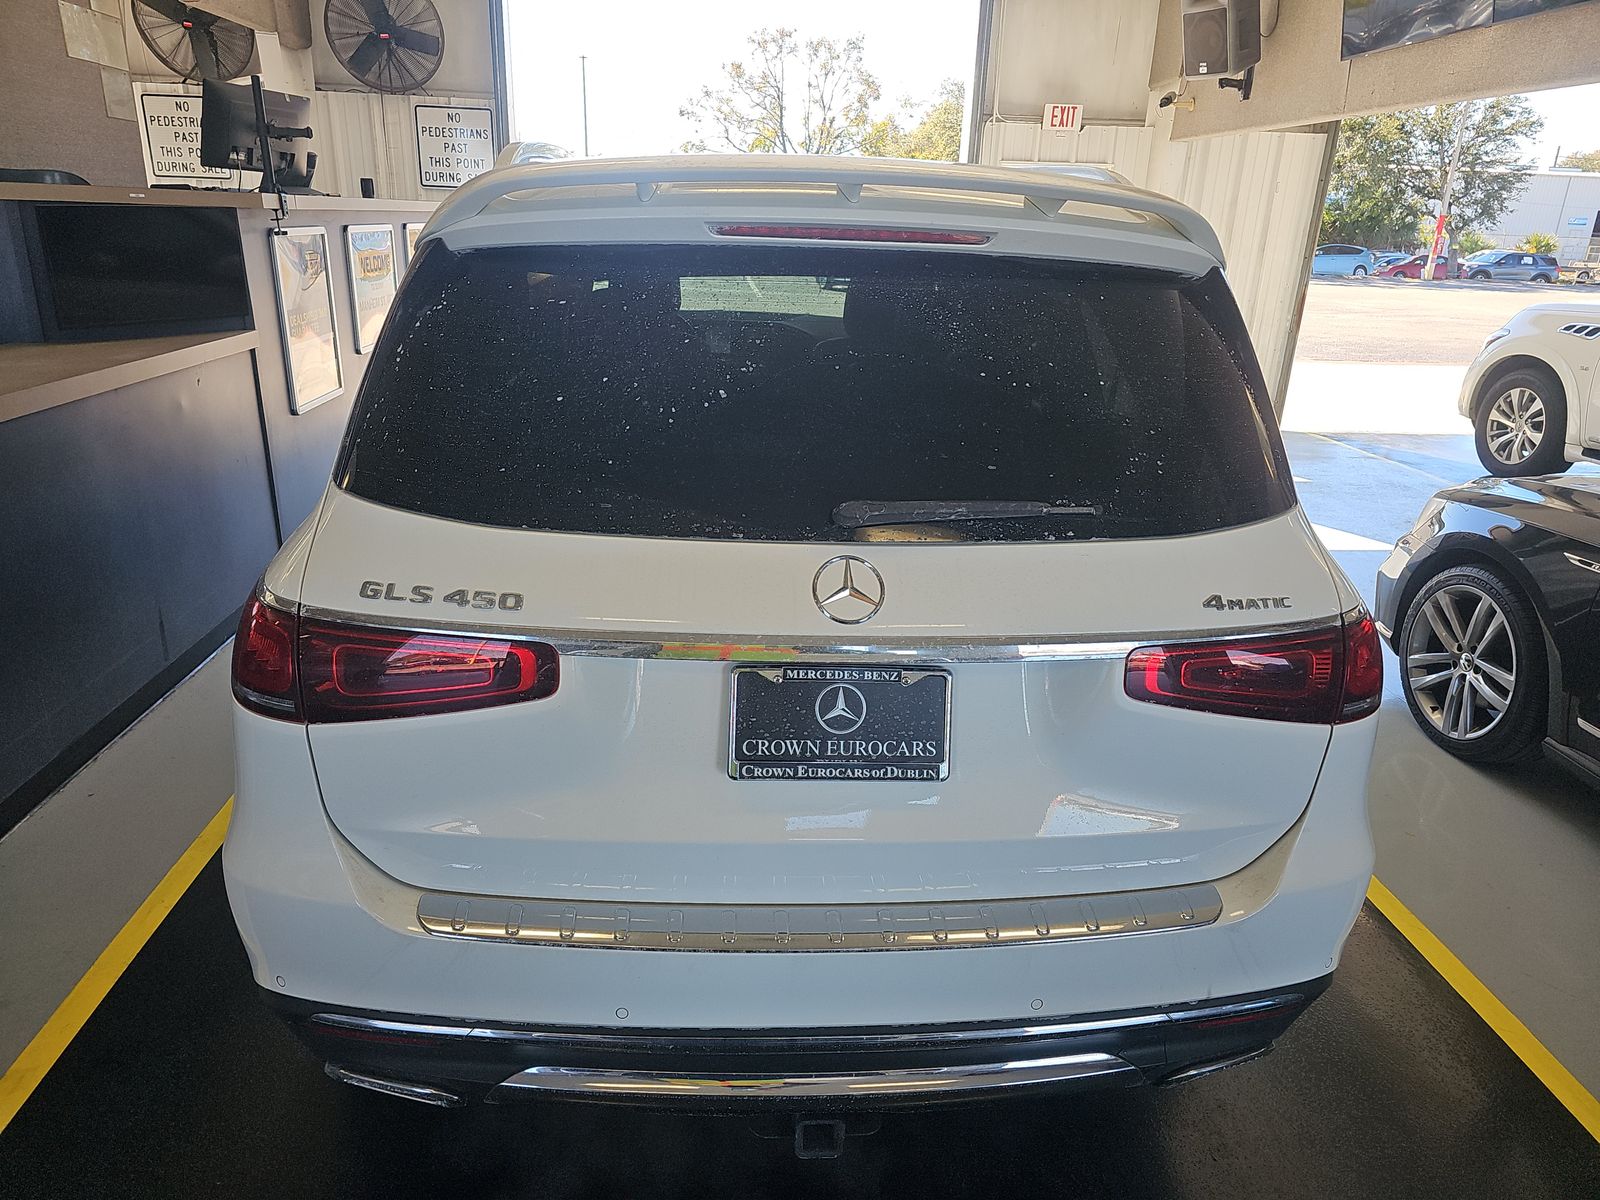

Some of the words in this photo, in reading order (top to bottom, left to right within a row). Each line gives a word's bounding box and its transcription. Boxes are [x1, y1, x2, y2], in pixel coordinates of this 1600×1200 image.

[175, 101, 190, 113] NO
[150, 115, 201, 128] PEDESTRI
[447, 112, 461, 124] NO
[1050, 105, 1078, 128] EXIT
[174, 131, 199, 143] PAST
[421, 126, 489, 140] PEDESTRIANS
[160, 146, 183, 158] THIS
[443, 142, 468, 154] PAST
[156, 161, 196, 173] DURING
[429, 156, 451, 168] THIS
[456, 157, 485, 170] POINT
[424, 171, 462, 183] DURING
[360, 253, 392, 274] WELCOME
[359, 580, 434, 604] GLS
[442, 588, 525, 611] 450
[1202, 594, 1292, 611] 4MATIC
[785, 668, 899, 682] MERCEDES-BENZ
[742, 738, 822, 757] CROWN
[827, 739, 937, 758] EUROCARS
[741, 764, 796, 778] CROWN
[797, 764, 870, 779] EUROCARS
[885, 765, 938, 780] DUBLIN
